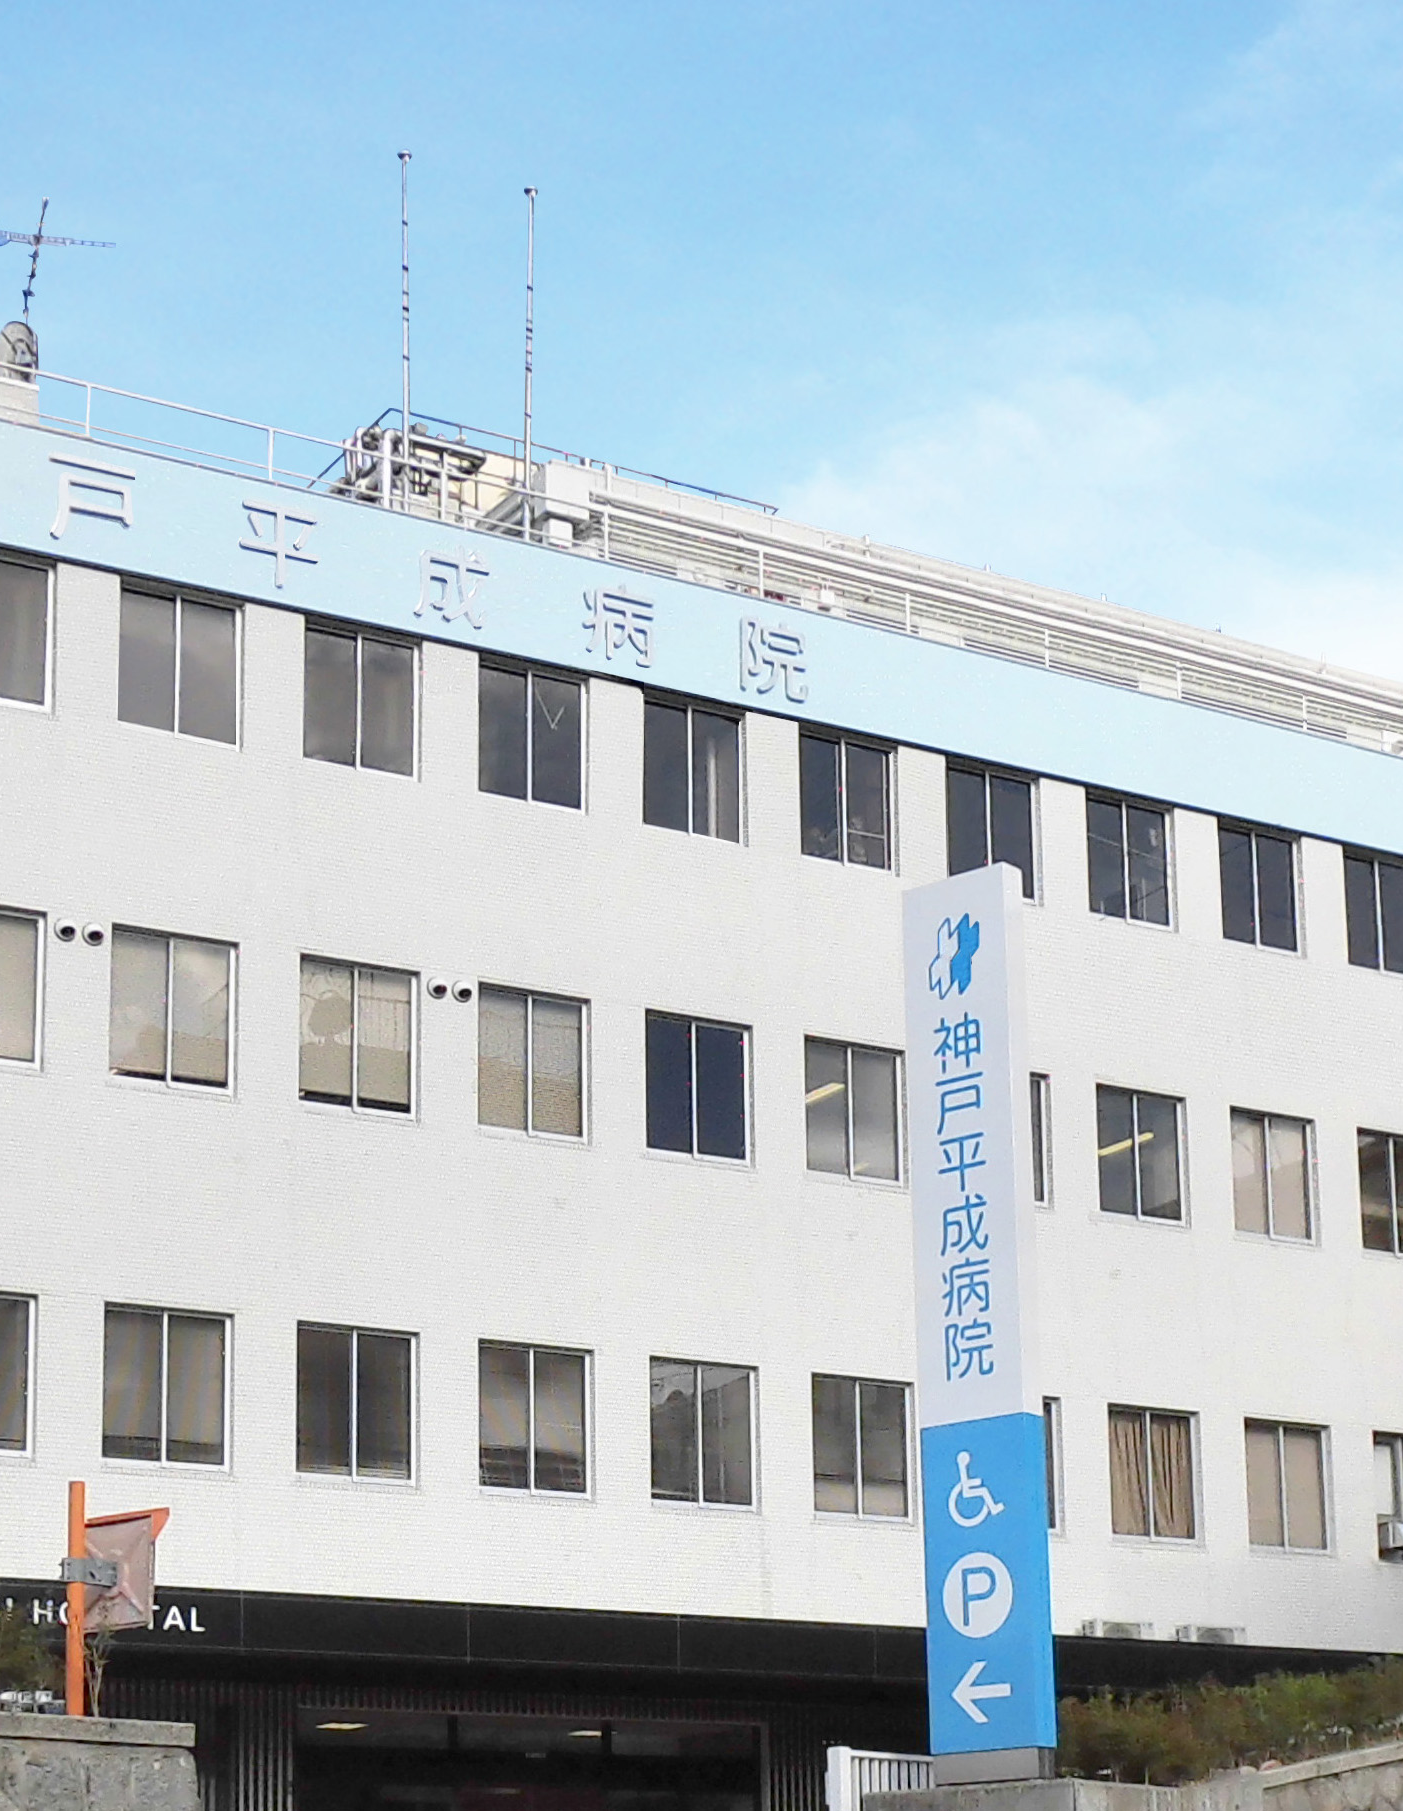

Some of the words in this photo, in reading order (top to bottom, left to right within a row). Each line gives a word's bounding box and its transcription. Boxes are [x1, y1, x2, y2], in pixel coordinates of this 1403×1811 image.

[933, 1011, 995, 1382] 神戸平成病院
[961, 1565, 996, 1627] P
